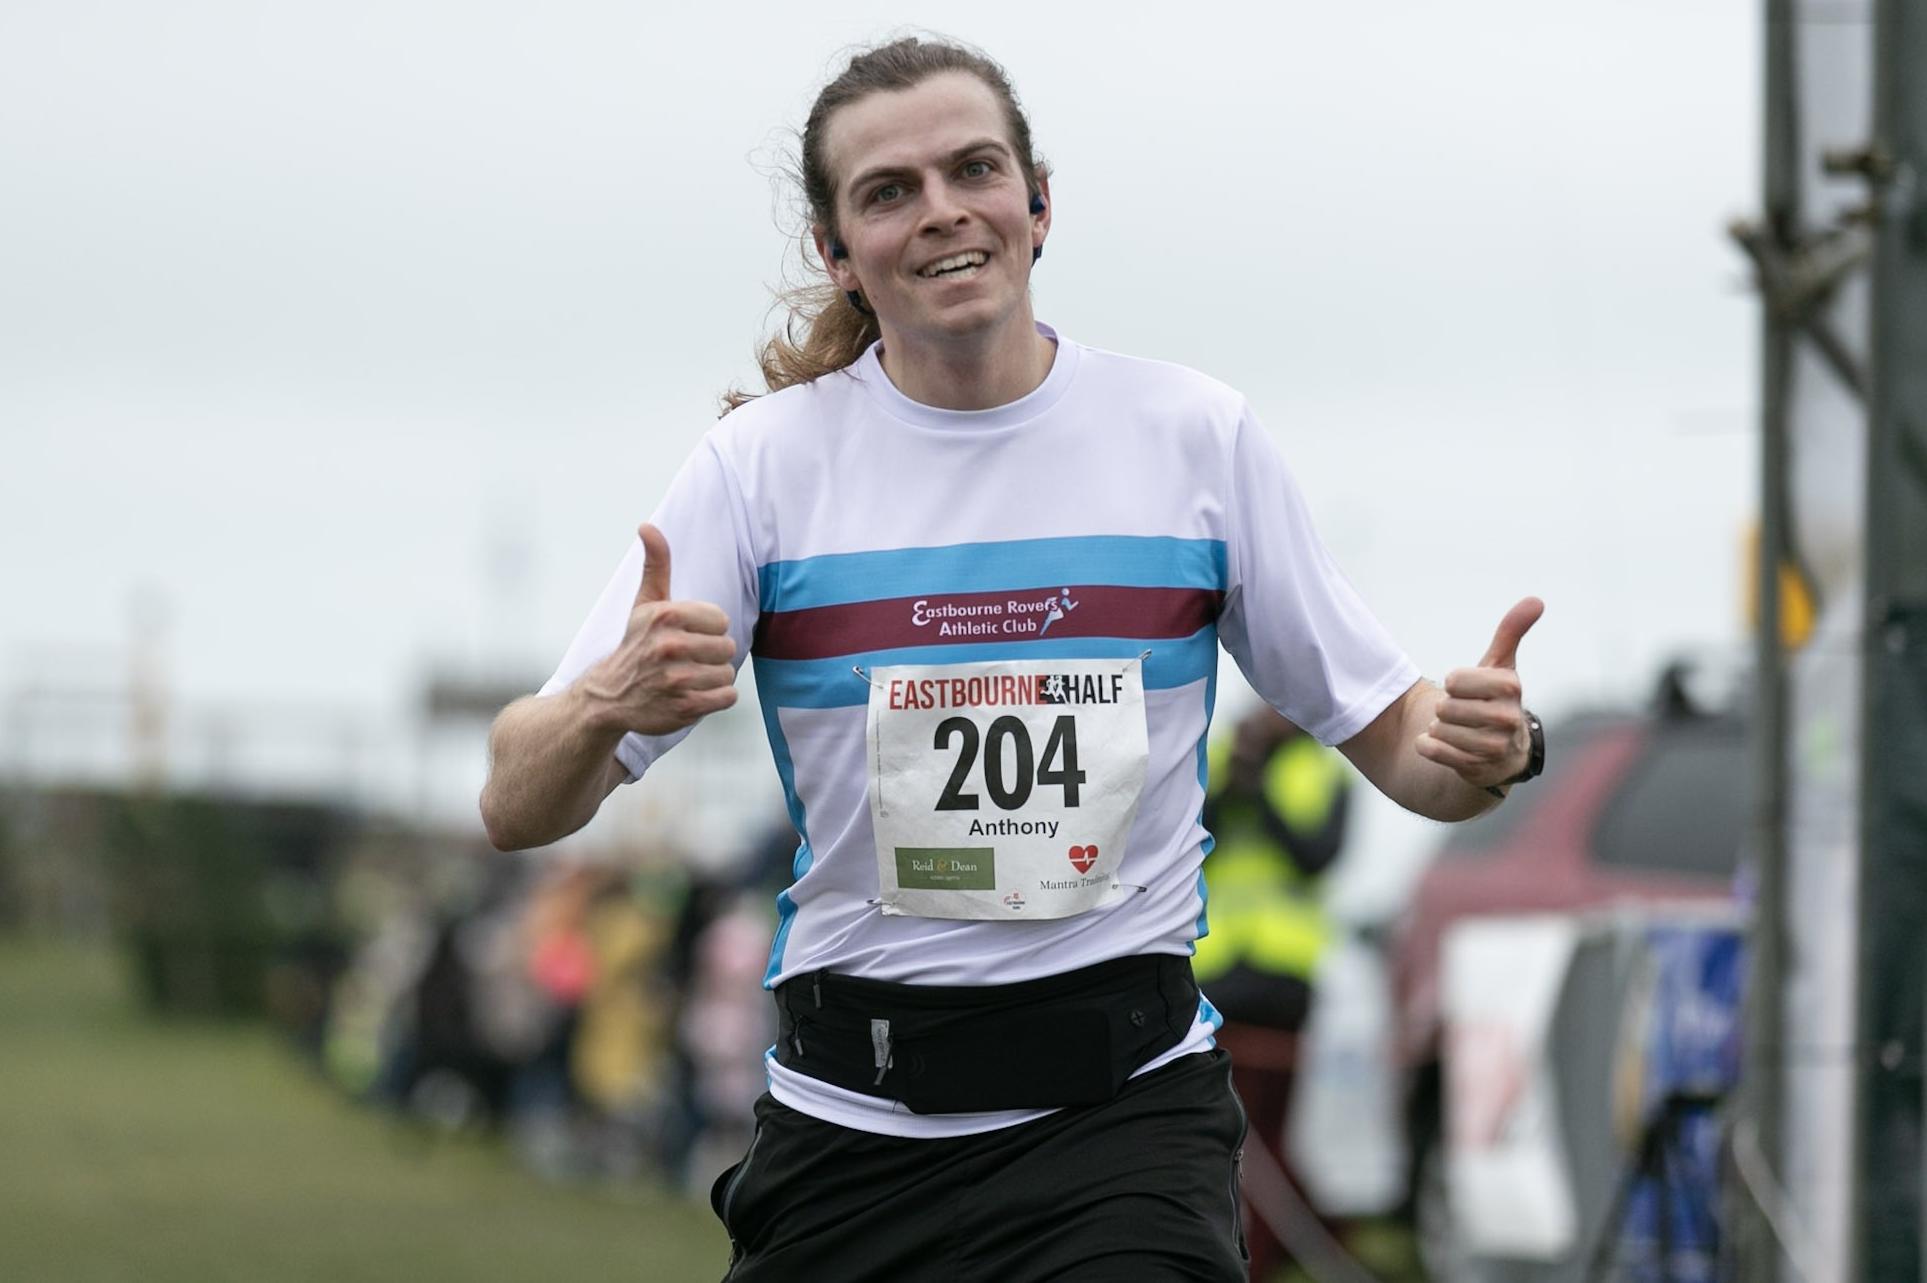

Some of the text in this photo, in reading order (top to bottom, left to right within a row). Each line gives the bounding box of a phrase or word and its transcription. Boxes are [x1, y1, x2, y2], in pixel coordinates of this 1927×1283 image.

[911, 600, 1003, 627] Eastbourne
[938, 617, 1037, 637] Athletic Club
[889, 674, 1123, 710] EASTBOURNE HALF
[934, 715, 1086, 811] 204
[968, 818, 1059, 838] Anthony
[912, 858, 934, 871] Reid
[951, 860, 978, 871] Dean
[1040, 879, 1078, 890] Mantra
